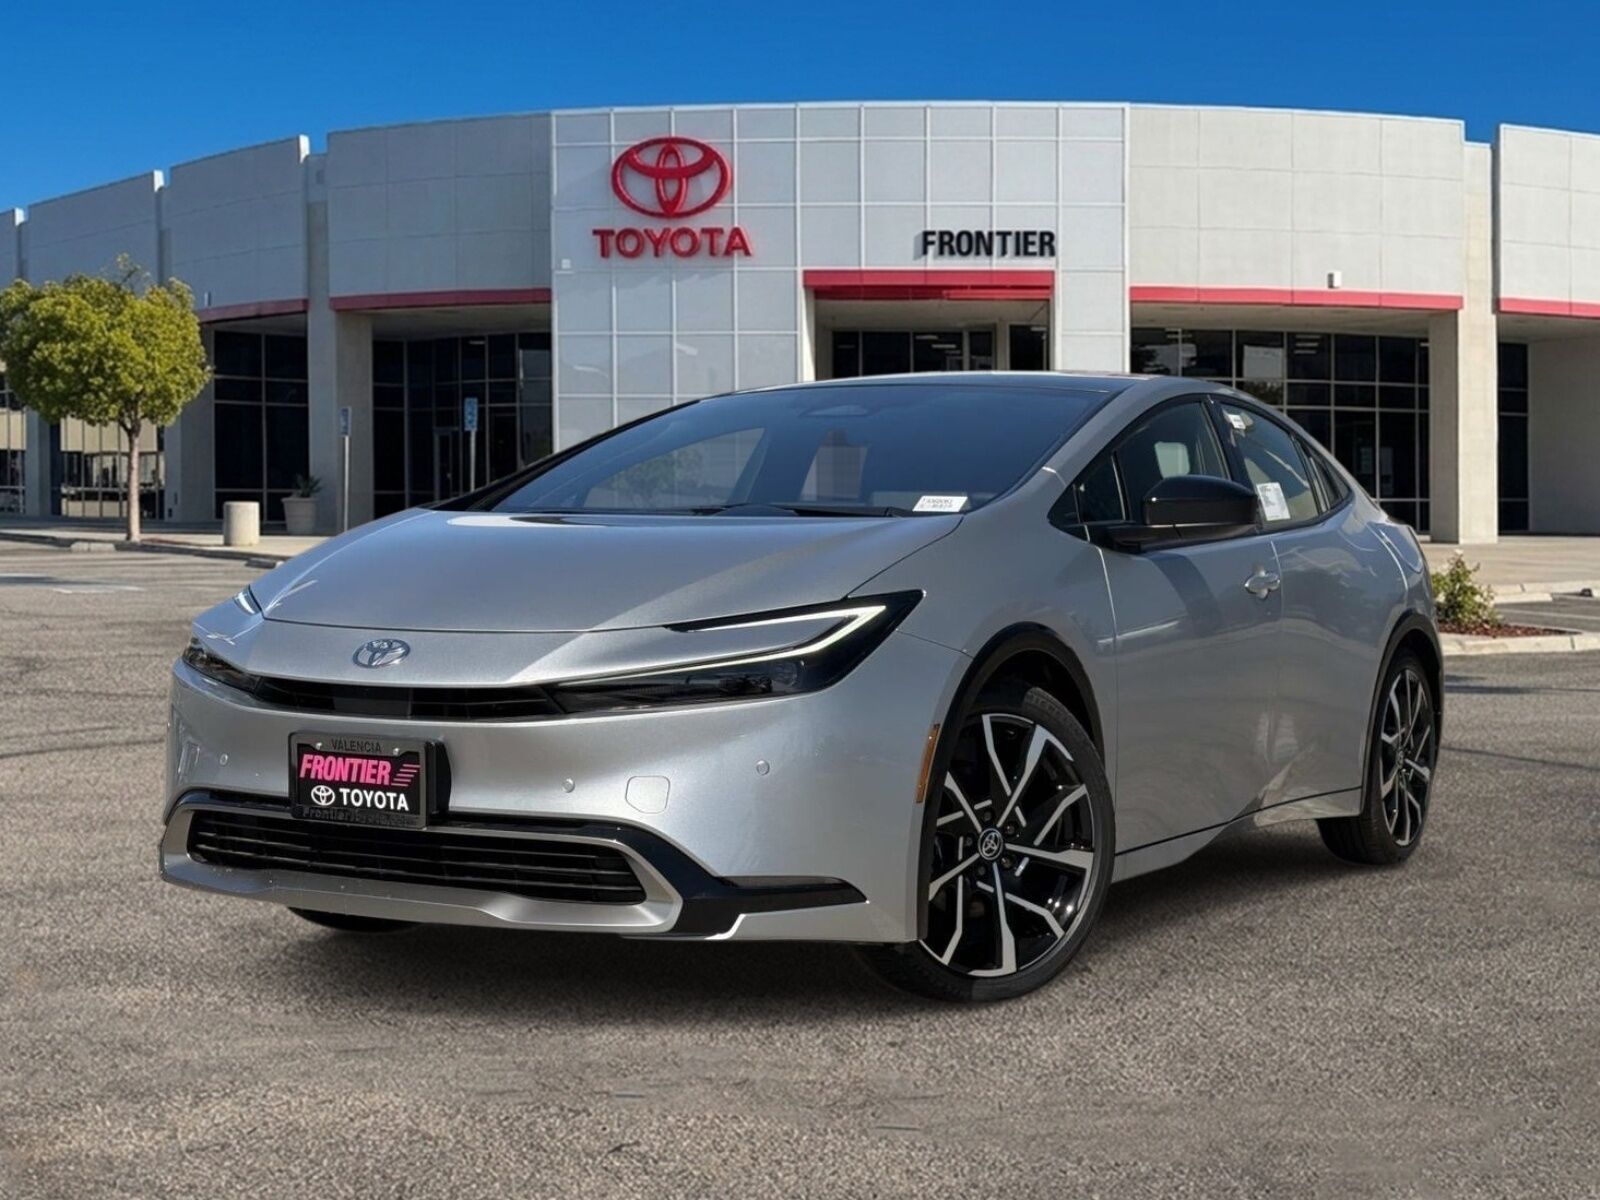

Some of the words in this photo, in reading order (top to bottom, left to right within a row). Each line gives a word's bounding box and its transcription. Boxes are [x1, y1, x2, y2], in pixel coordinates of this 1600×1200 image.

[592, 226, 752, 259] TOYOTA
[921, 230, 1056, 257] FRONTIER
[331, 738, 382, 753] VALENCIA
[300, 753, 392, 786] FRONTIER
[339, 788, 409, 811] TOYOTA
